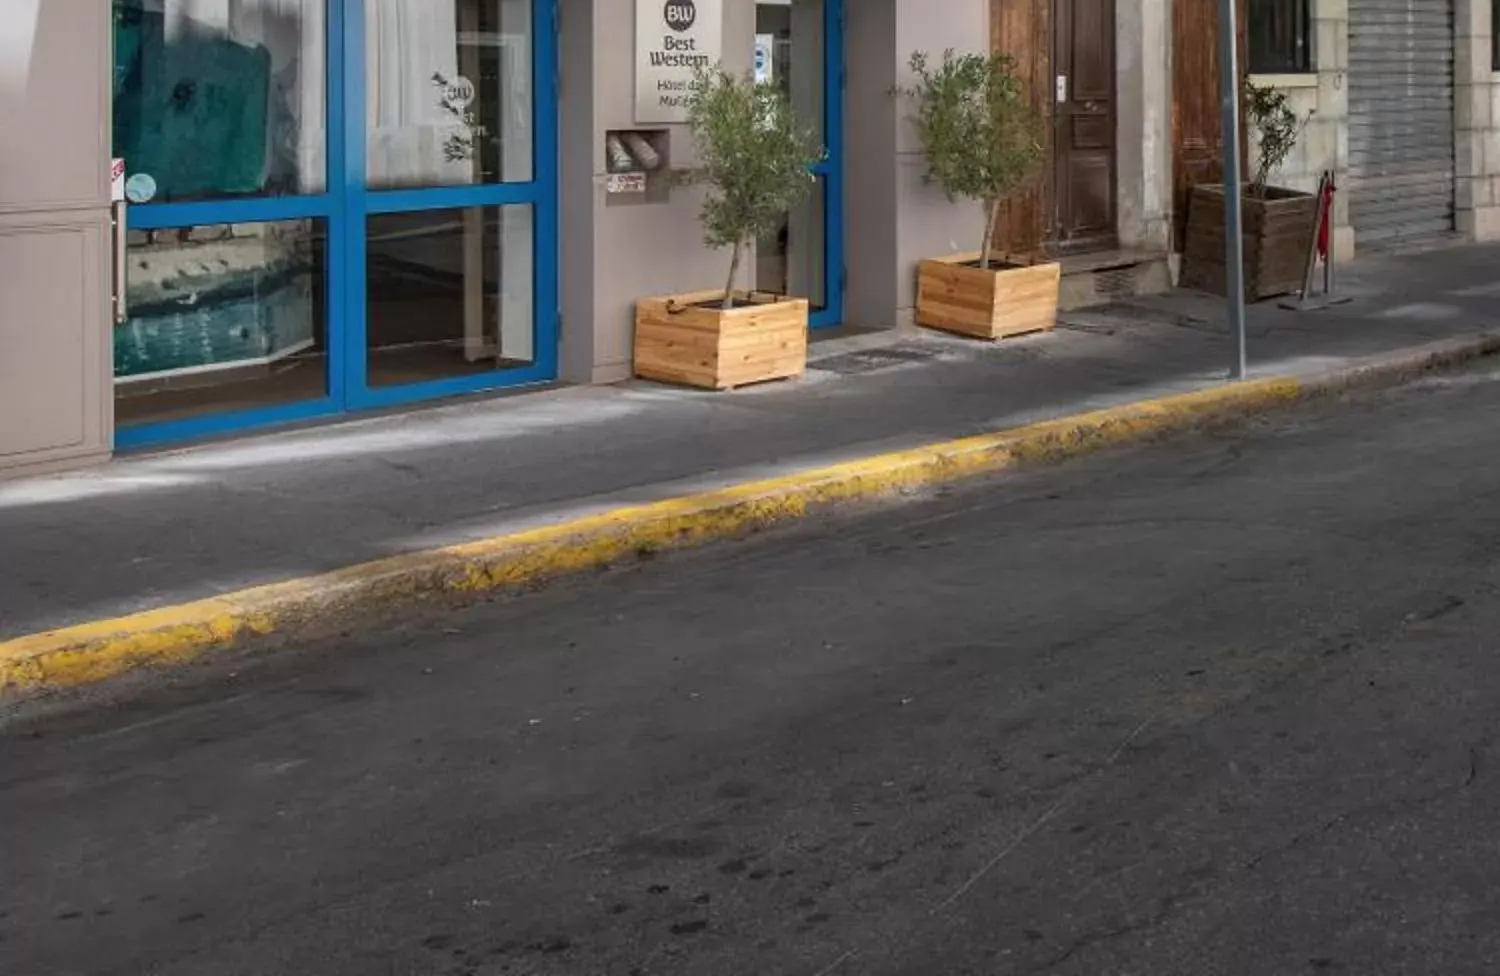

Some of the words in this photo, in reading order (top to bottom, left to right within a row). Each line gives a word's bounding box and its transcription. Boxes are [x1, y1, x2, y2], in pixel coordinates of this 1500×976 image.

[667, 5, 693, 22] BW
[664, 35, 696, 51] Best
[650, 52, 709, 67] Western
